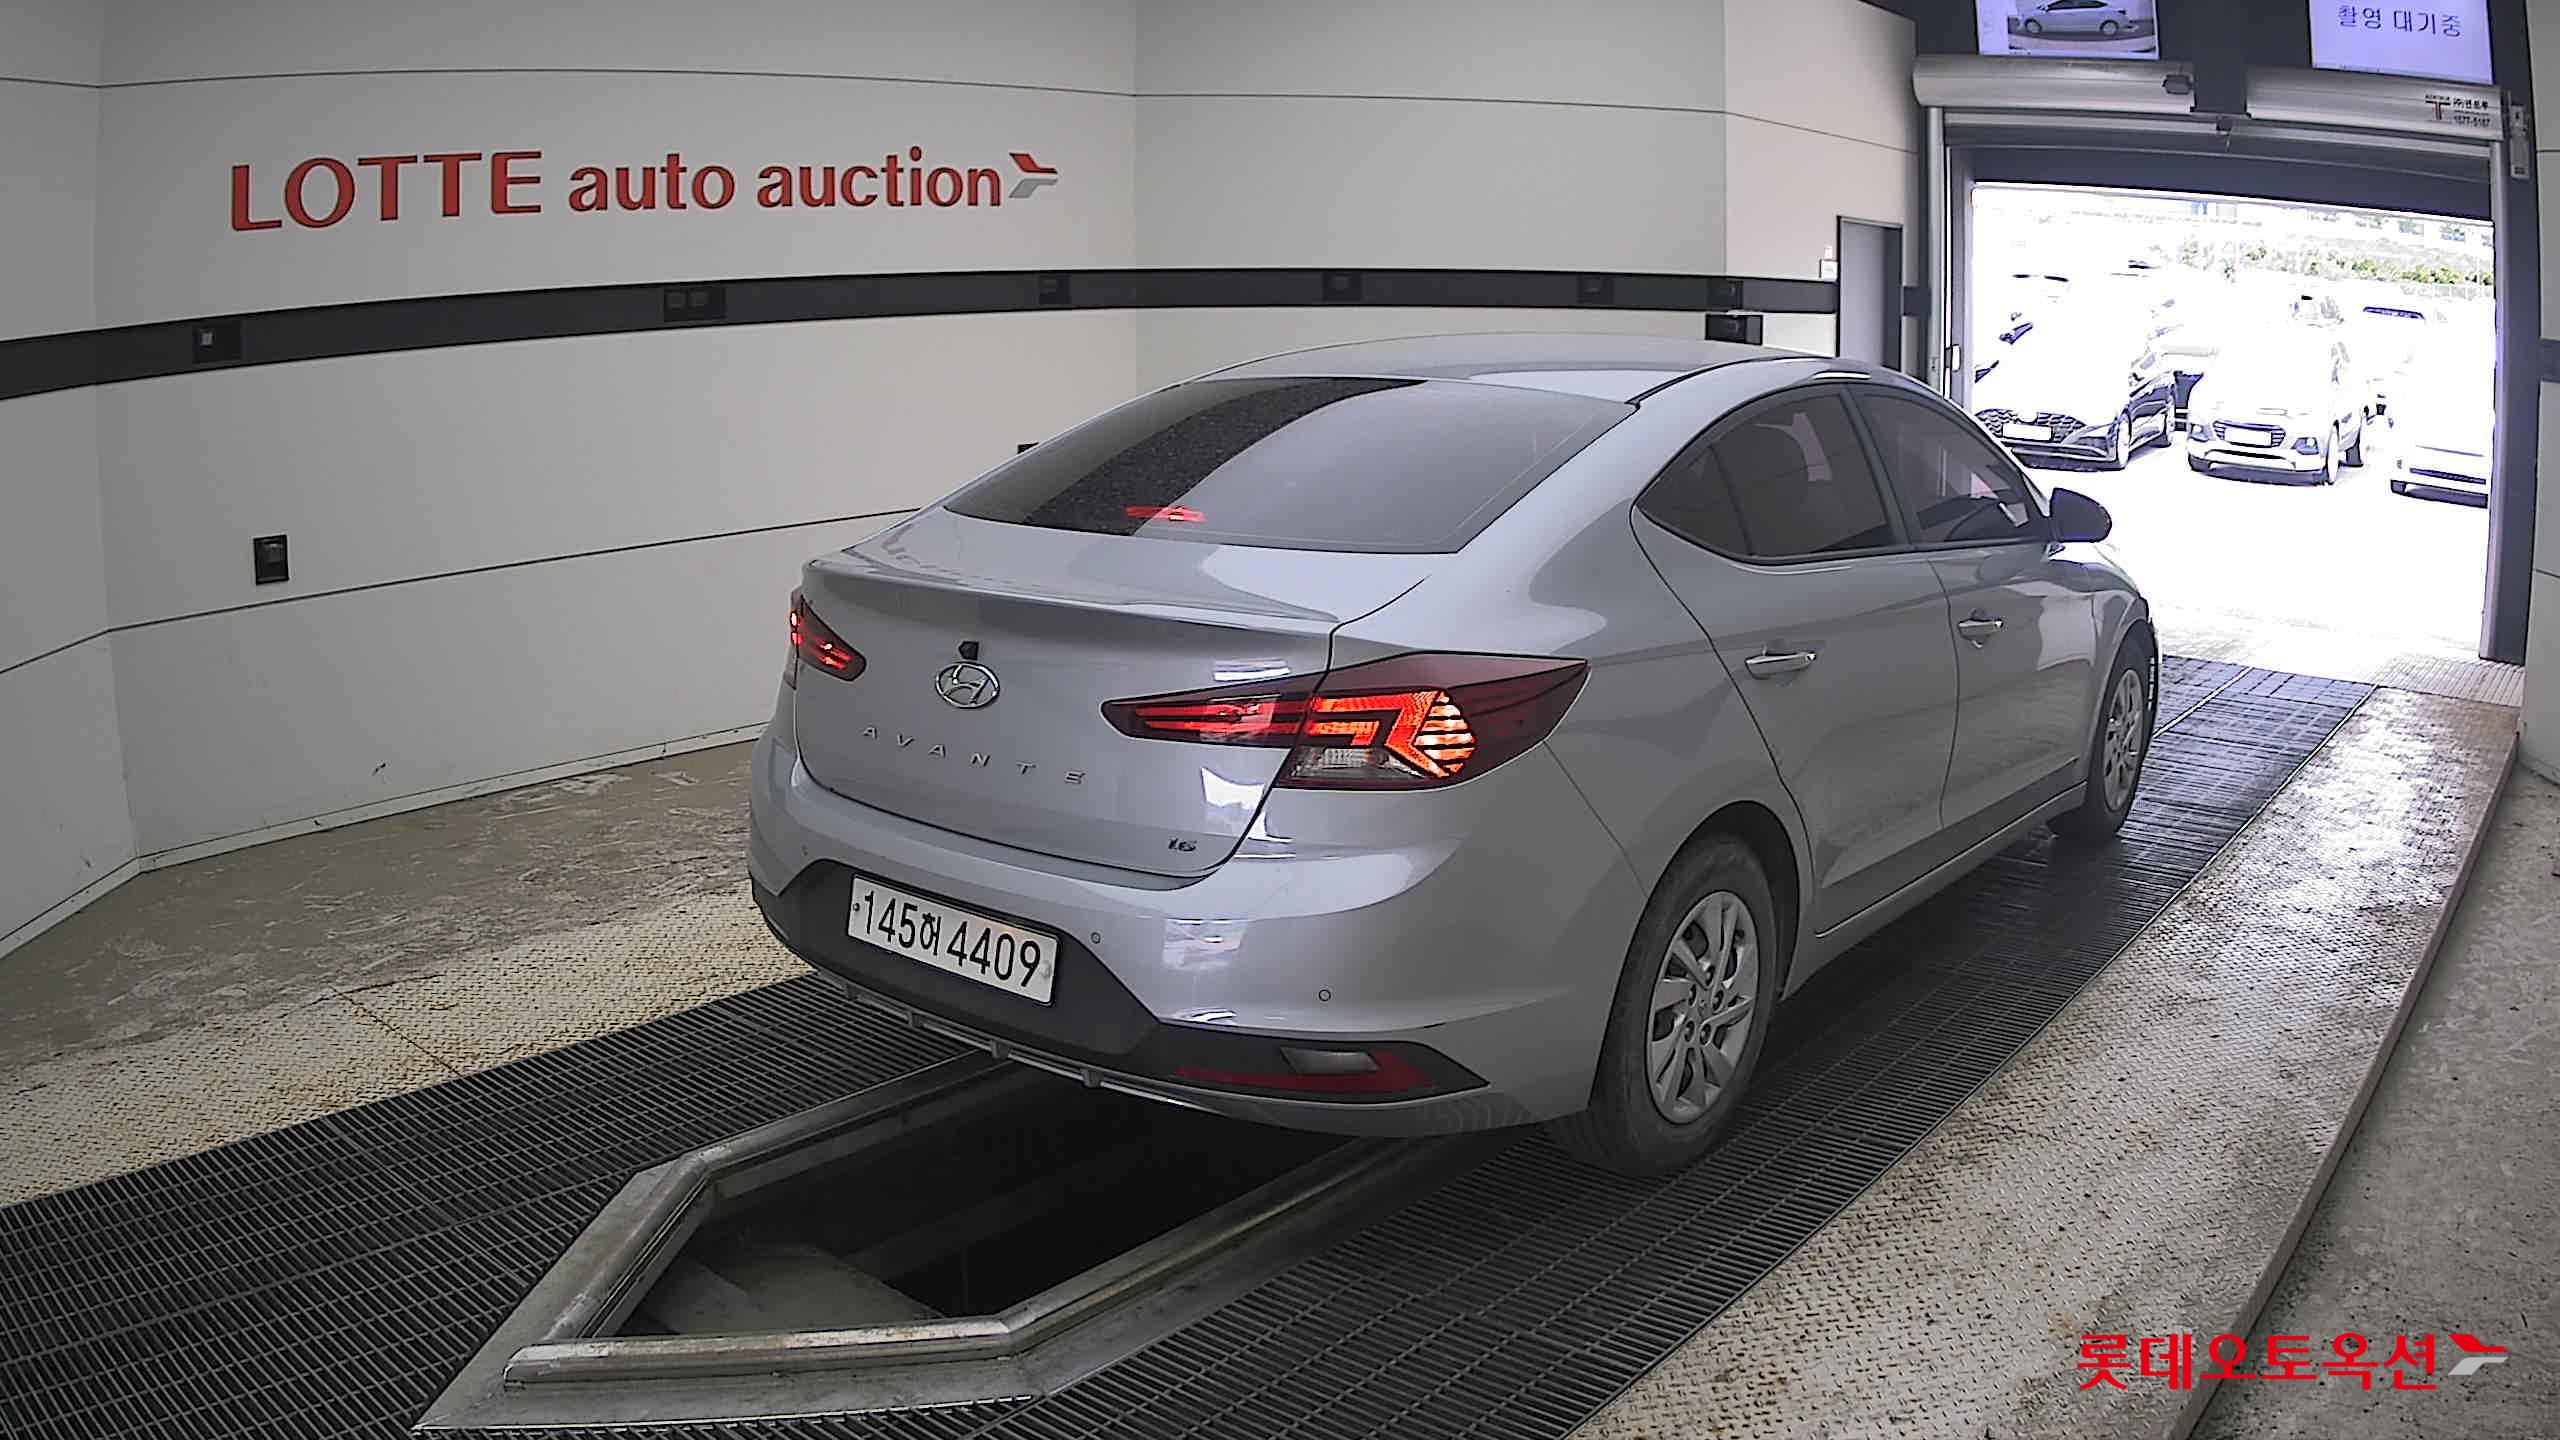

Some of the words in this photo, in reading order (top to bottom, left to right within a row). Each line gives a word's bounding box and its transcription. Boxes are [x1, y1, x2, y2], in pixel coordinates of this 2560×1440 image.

[2338, 4, 2382, 29] 촬영
[2393, 9, 2462, 38] 대기중
[231, 150, 543, 232] LOTTE
[567, 152, 736, 212] auto
[757, 146, 1001, 208] auction
[862, 726, 1087, 785] AVANTE
[945, 919, 1042, 988] 4409
